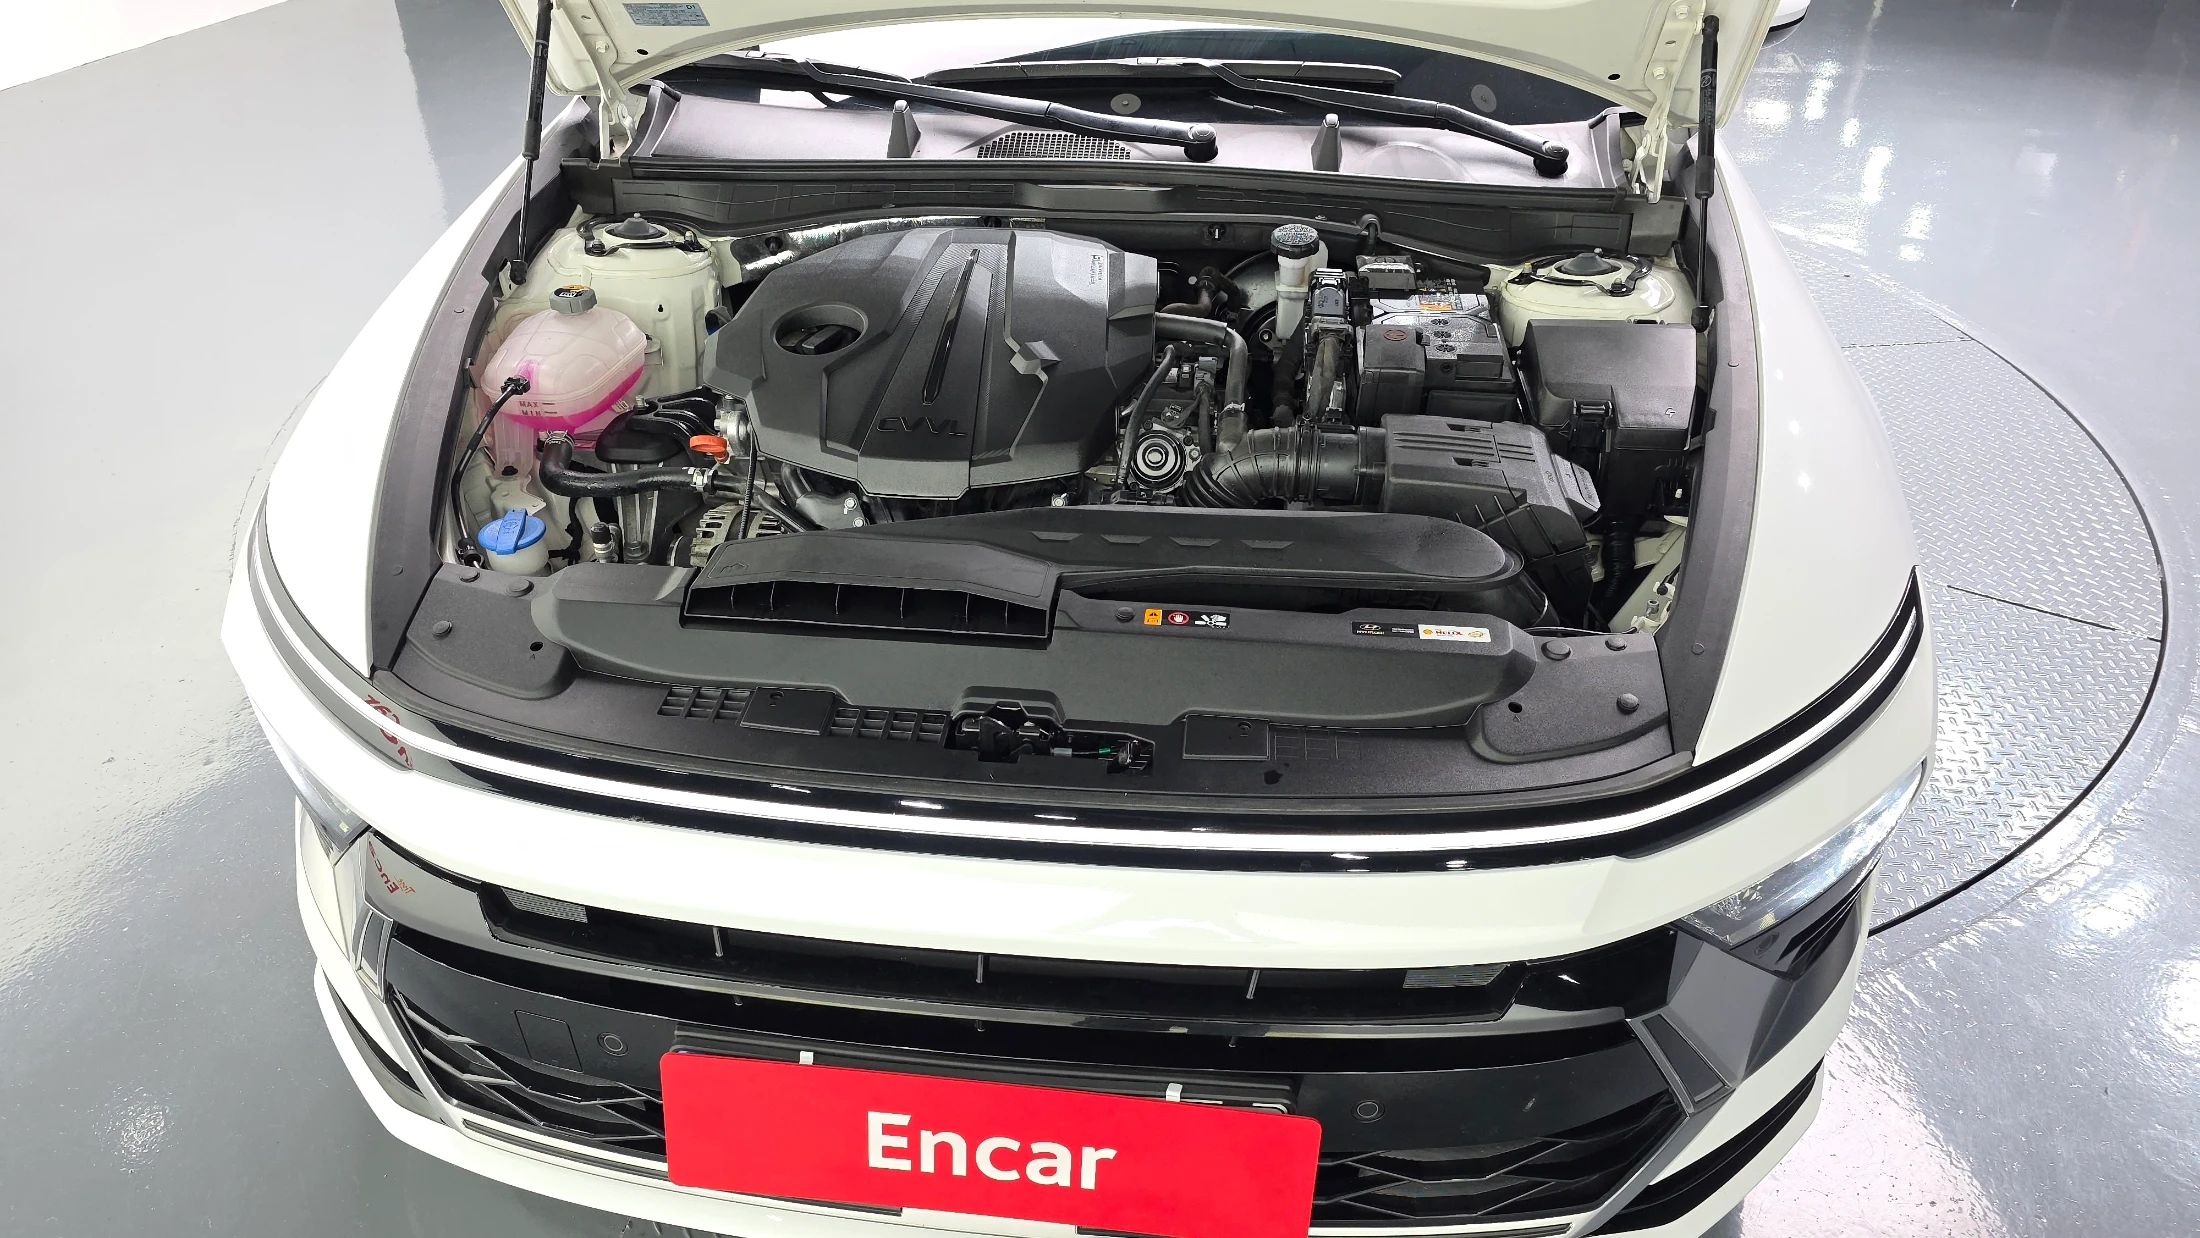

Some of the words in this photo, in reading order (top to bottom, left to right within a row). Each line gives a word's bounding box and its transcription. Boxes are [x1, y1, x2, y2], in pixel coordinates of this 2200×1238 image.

[518, 400, 539, 408] MAX
[876, 416, 968, 437] CVVL
[867, 1110, 1118, 1190] Encar
